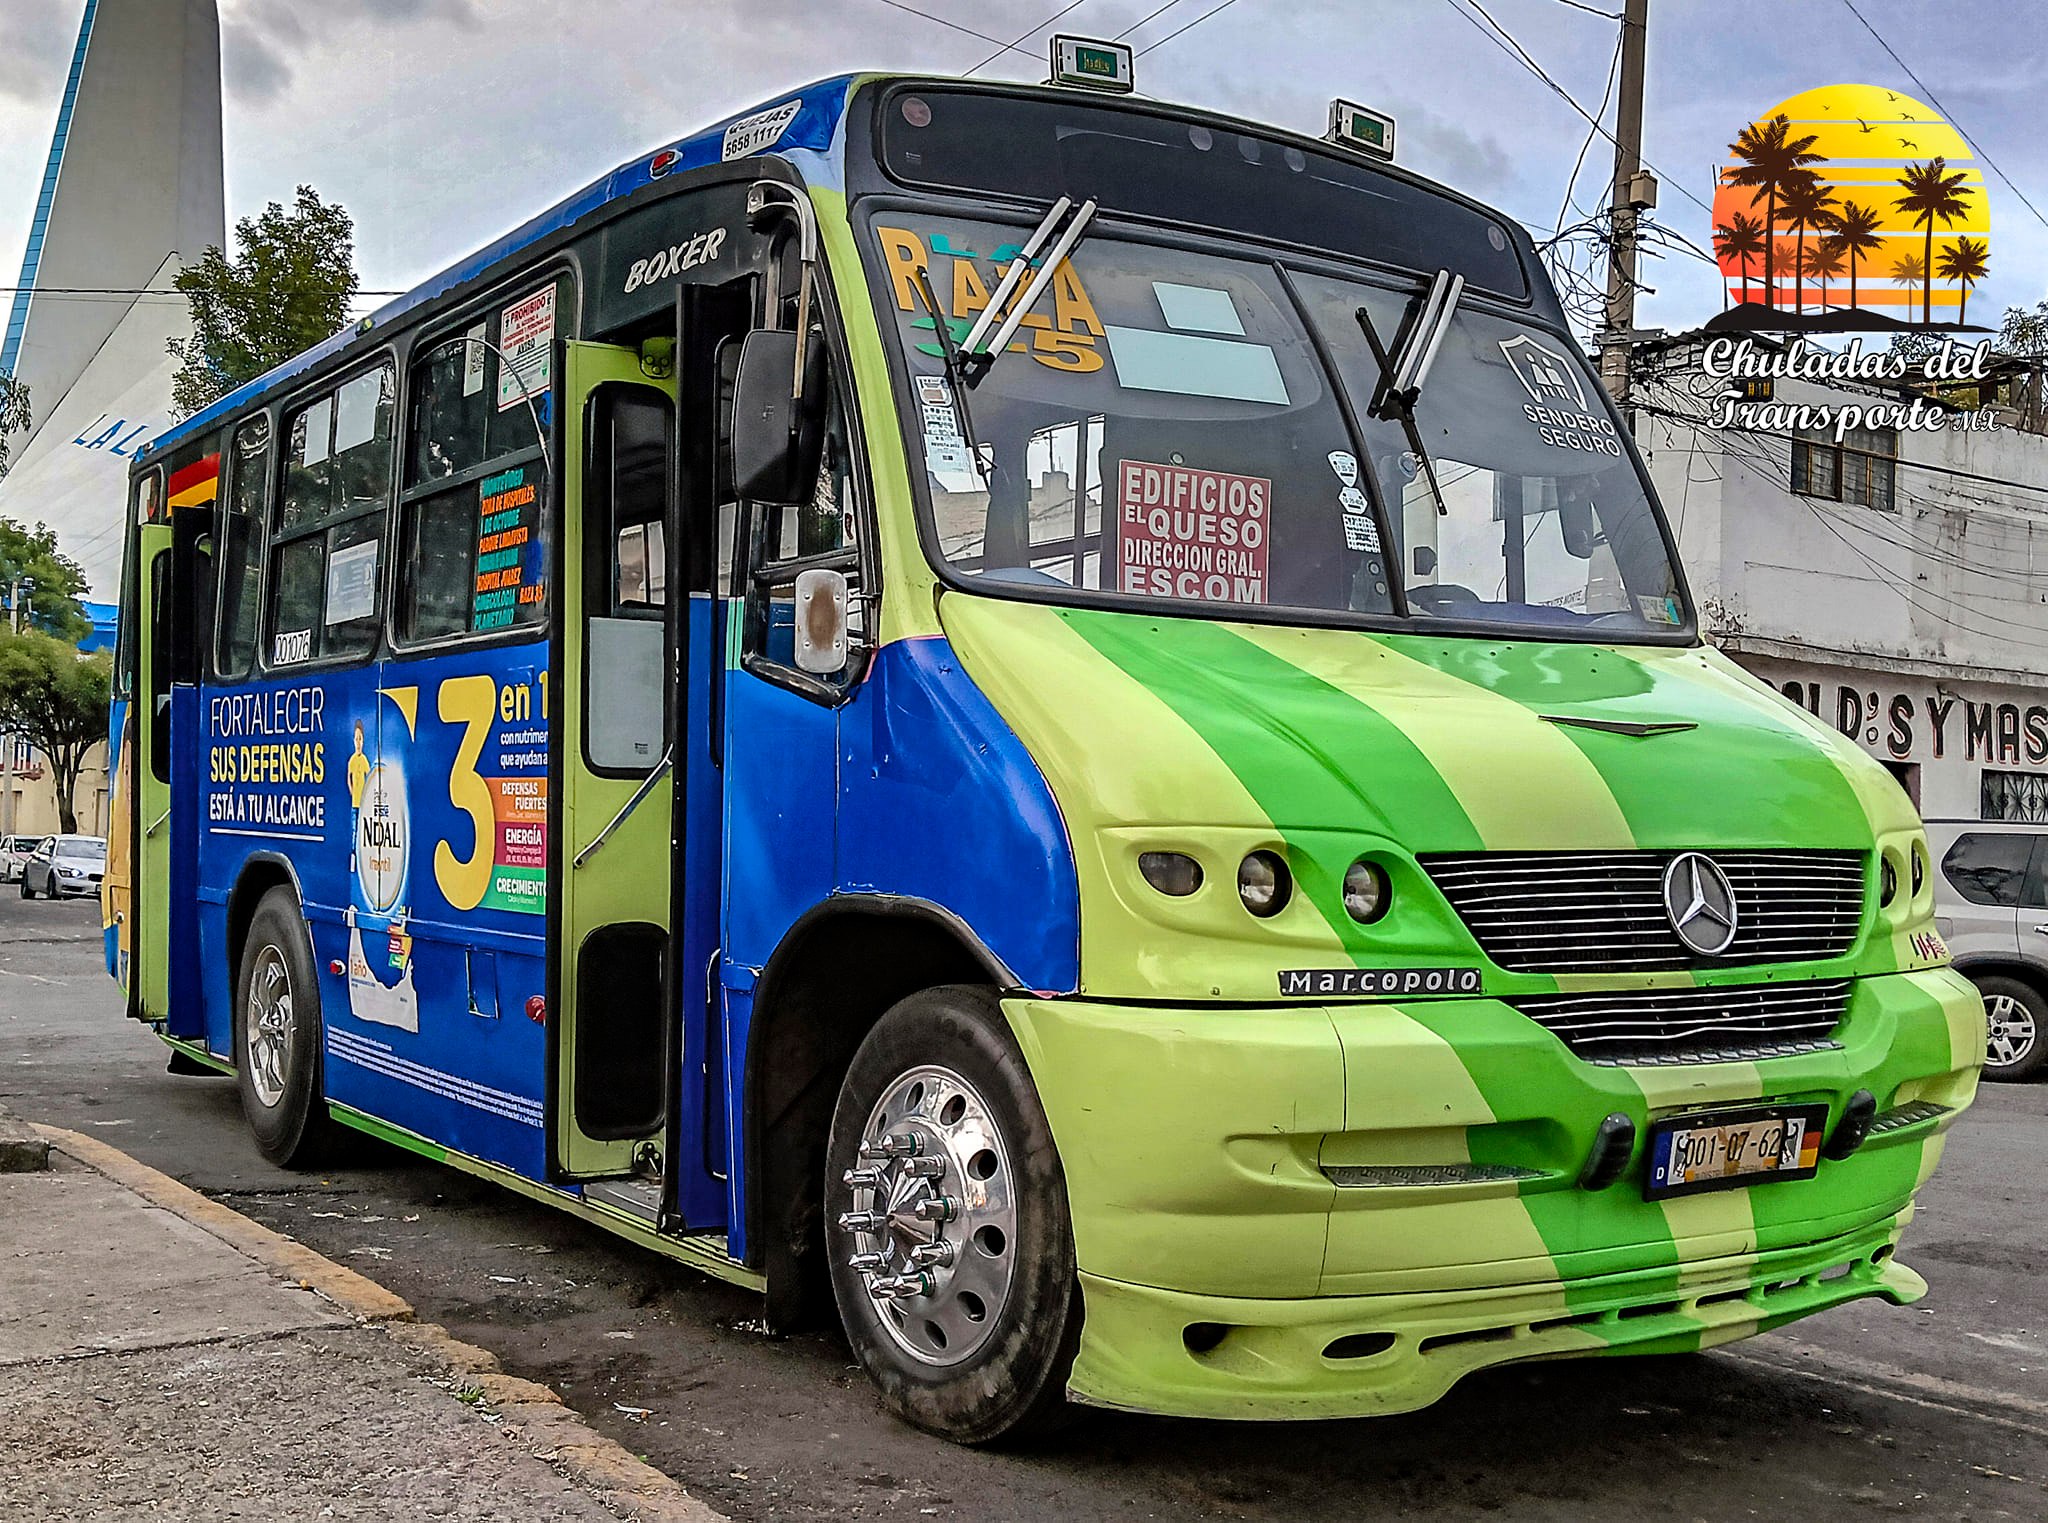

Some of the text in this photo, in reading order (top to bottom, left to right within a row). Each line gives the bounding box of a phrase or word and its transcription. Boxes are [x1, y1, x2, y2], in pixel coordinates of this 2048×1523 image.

[729, 107, 794, 135] QUEJAS
[725, 133, 750, 157] 5658
[877, 226, 1105, 337] RAZA
[510, 295, 546, 325] PROHIBIDO
[1523, 403, 1617, 437] SENDERO
[1538, 426, 1621, 457] SEGURO
[1125, 466, 1264, 519] EDIFICIOS
[1125, 504, 1263, 549] EL QUESO
[1124, 537, 1262, 578] DIRECCION GRAL.
[1124, 565, 1262, 604] ESCOM
[275, 632, 310, 663] 001076
[211, 686, 325, 738] FORTALECER
[1925, 695, 1955, 758] Y
[500, 732, 514, 745] con
[210, 743, 325, 784] SUS DEFENSAS
[500, 753, 513, 770] que
[514, 749, 542, 769] ayudan
[434, 670, 548, 911] 3 en 1
[502, 782, 539, 796] DEFENSAS
[515, 796, 547, 811] FUERTES
[210, 786, 325, 827] ESTÁ A TU ALCANCE
[505, 823, 543, 846] ENERGÍA
[1288, 968, 1477, 993] Marcopolo
[1656, 1166, 1665, 1180] D
